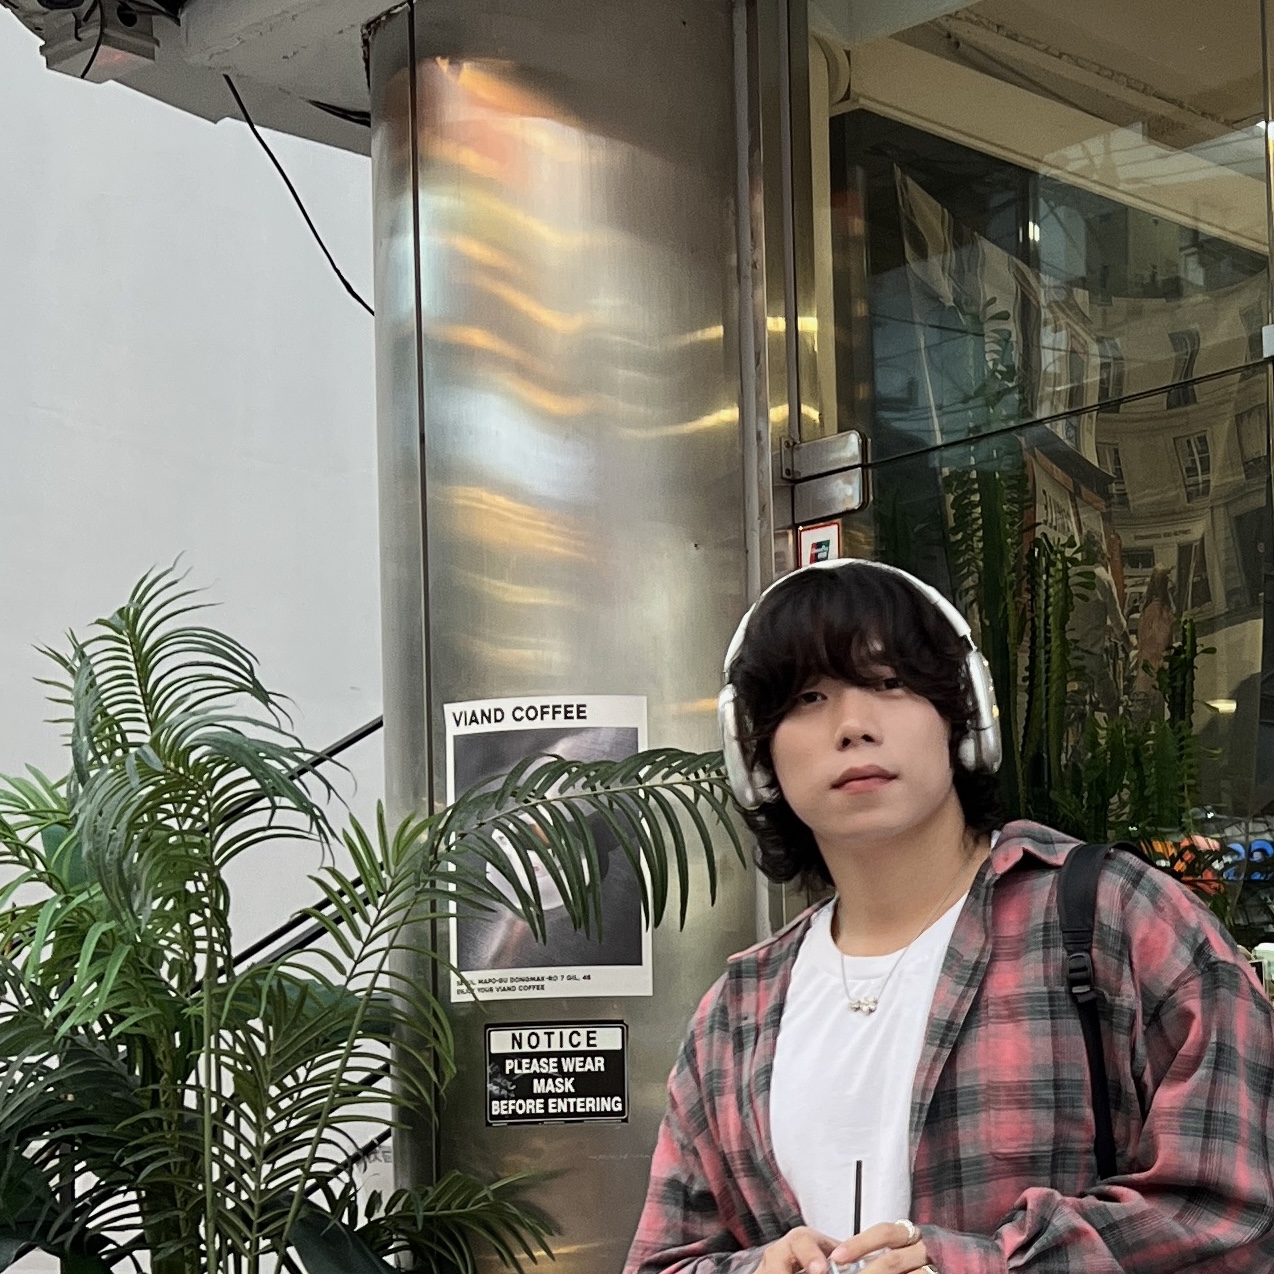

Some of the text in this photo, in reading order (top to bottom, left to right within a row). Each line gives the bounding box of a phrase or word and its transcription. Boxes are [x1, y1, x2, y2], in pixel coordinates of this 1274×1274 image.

[452, 704, 587, 727] VIAND COFFEE
[511, 1030, 598, 1050] NOTICE
[505, 1056, 606, 1075] PLEASE WEAR
[532, 1077, 576, 1094] MASK
[491, 1096, 623, 1116] BEFORE ENTERING
